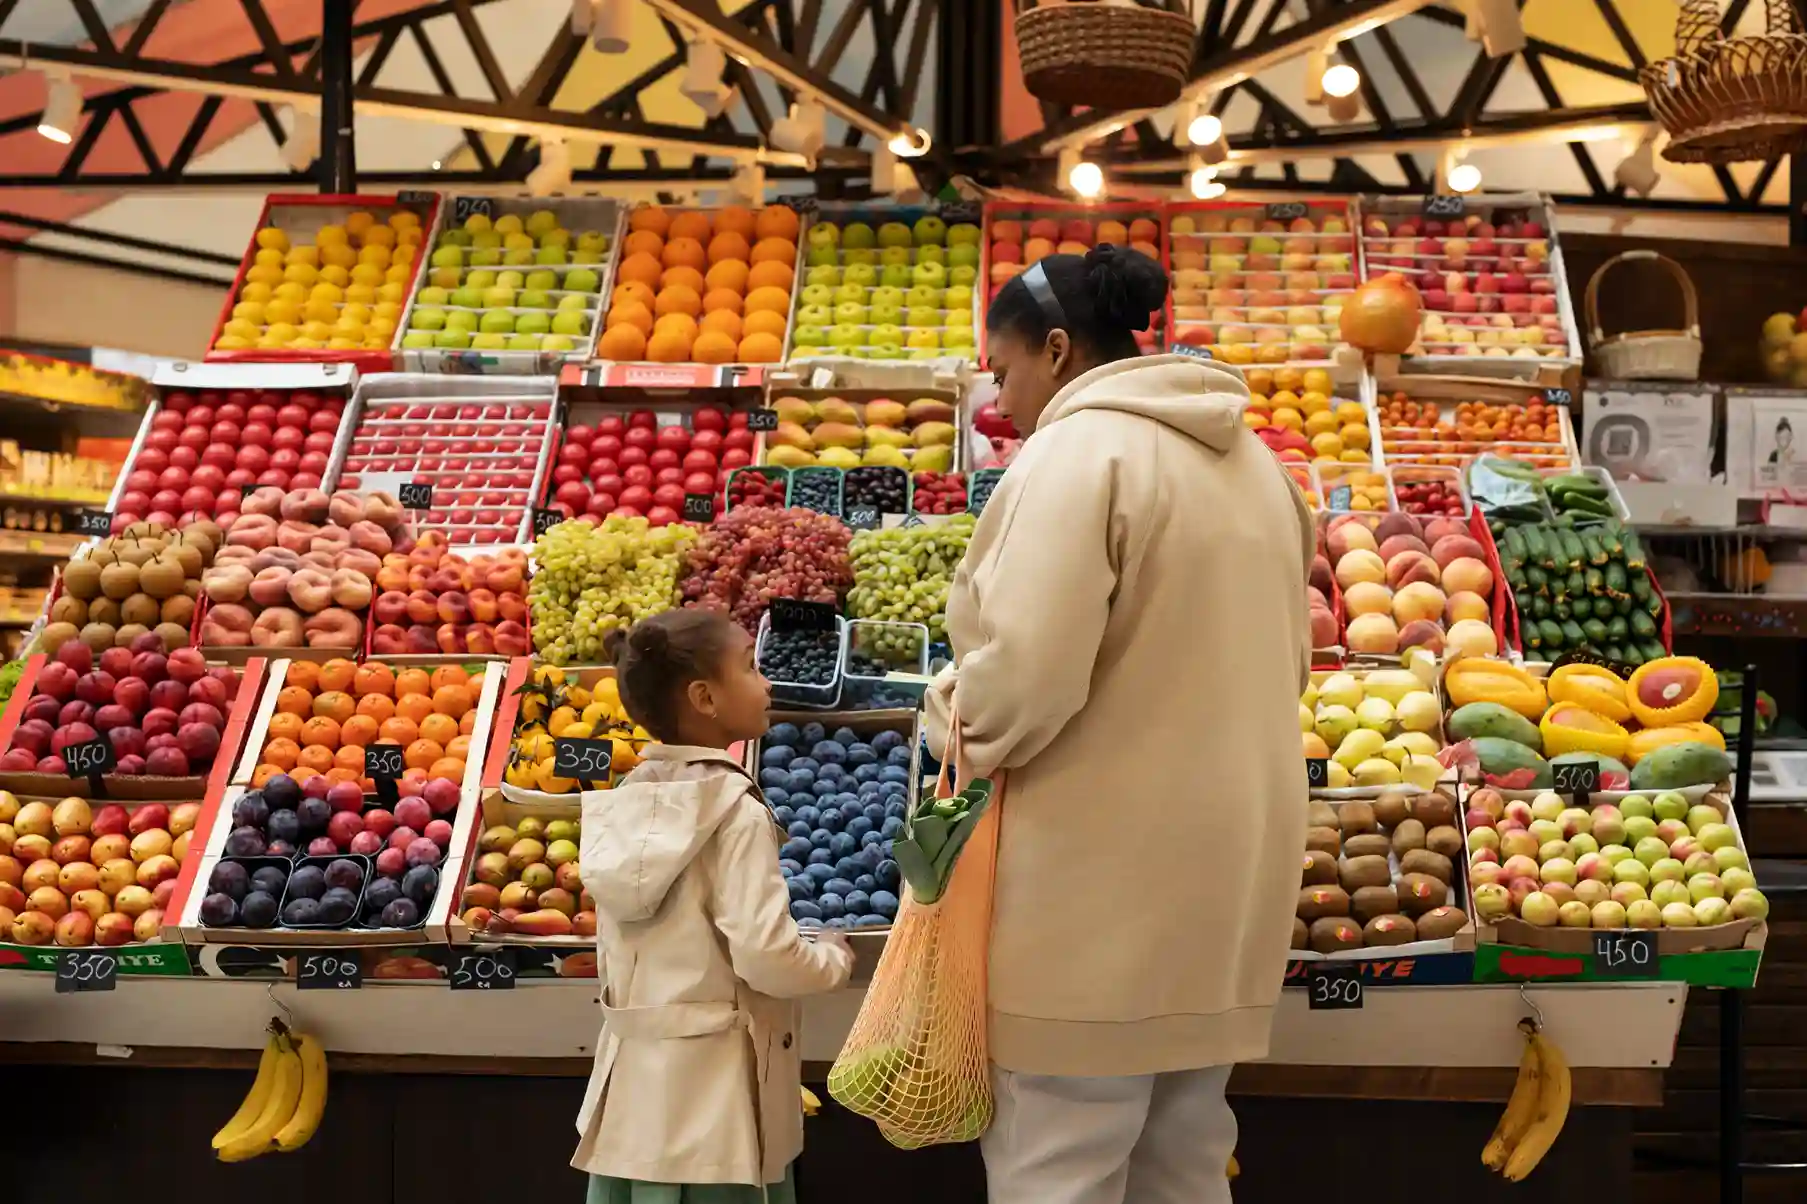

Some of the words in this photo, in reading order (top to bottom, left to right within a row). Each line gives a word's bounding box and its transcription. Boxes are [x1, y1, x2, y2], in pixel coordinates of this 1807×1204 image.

[402, 485, 431, 504] 500
[685, 498, 712, 514] 500
[81, 515, 109, 529] 350
[850, 510, 875, 526] 500
[67, 744, 106, 771] 450
[367, 750, 402, 774] 350
[557, 744, 611, 772] 350
[1556, 766, 1595, 790] 500
[1597, 938, 1649, 967] 450
[59, 953, 115, 980] 350
[300, 956, 357, 978] 500
[454, 957, 512, 984] 500
[1316, 977, 1360, 1002] 350
